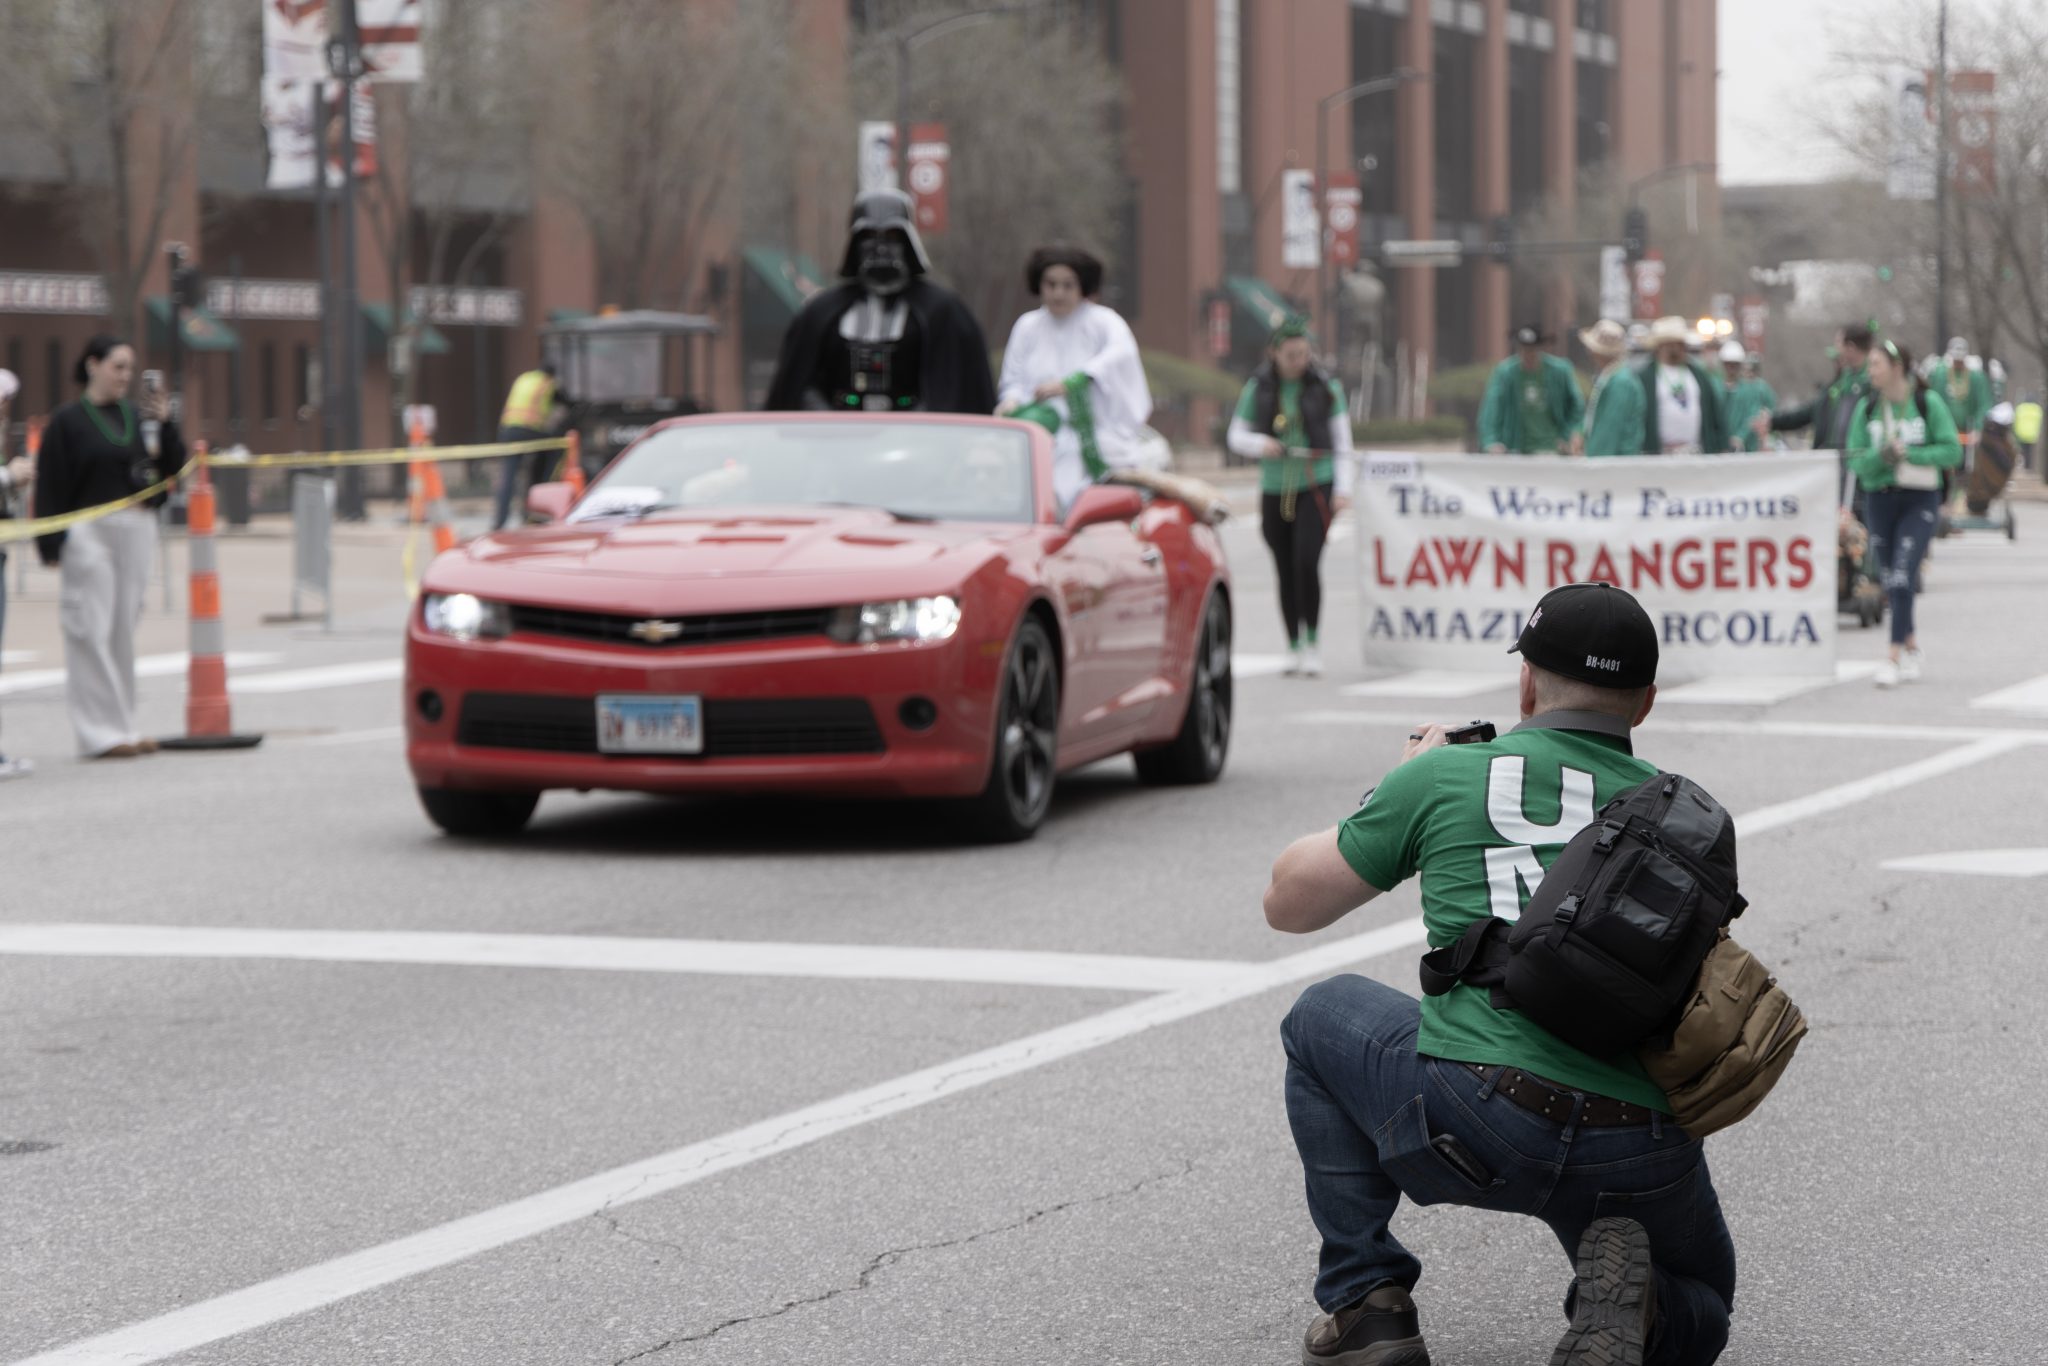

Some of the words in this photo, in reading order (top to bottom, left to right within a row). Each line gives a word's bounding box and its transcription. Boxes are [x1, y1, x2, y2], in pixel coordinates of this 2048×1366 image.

[1391, 484, 1464, 516] The
[1491, 486, 1612, 520] World
[1640, 487, 1800, 520] Famous
[1373, 537, 1526, 589] LAWN
[1546, 536, 1815, 590] RANGERS
[1368, 606, 1522, 641] AMAZI
[1661, 609, 1821, 646] RCOLA
